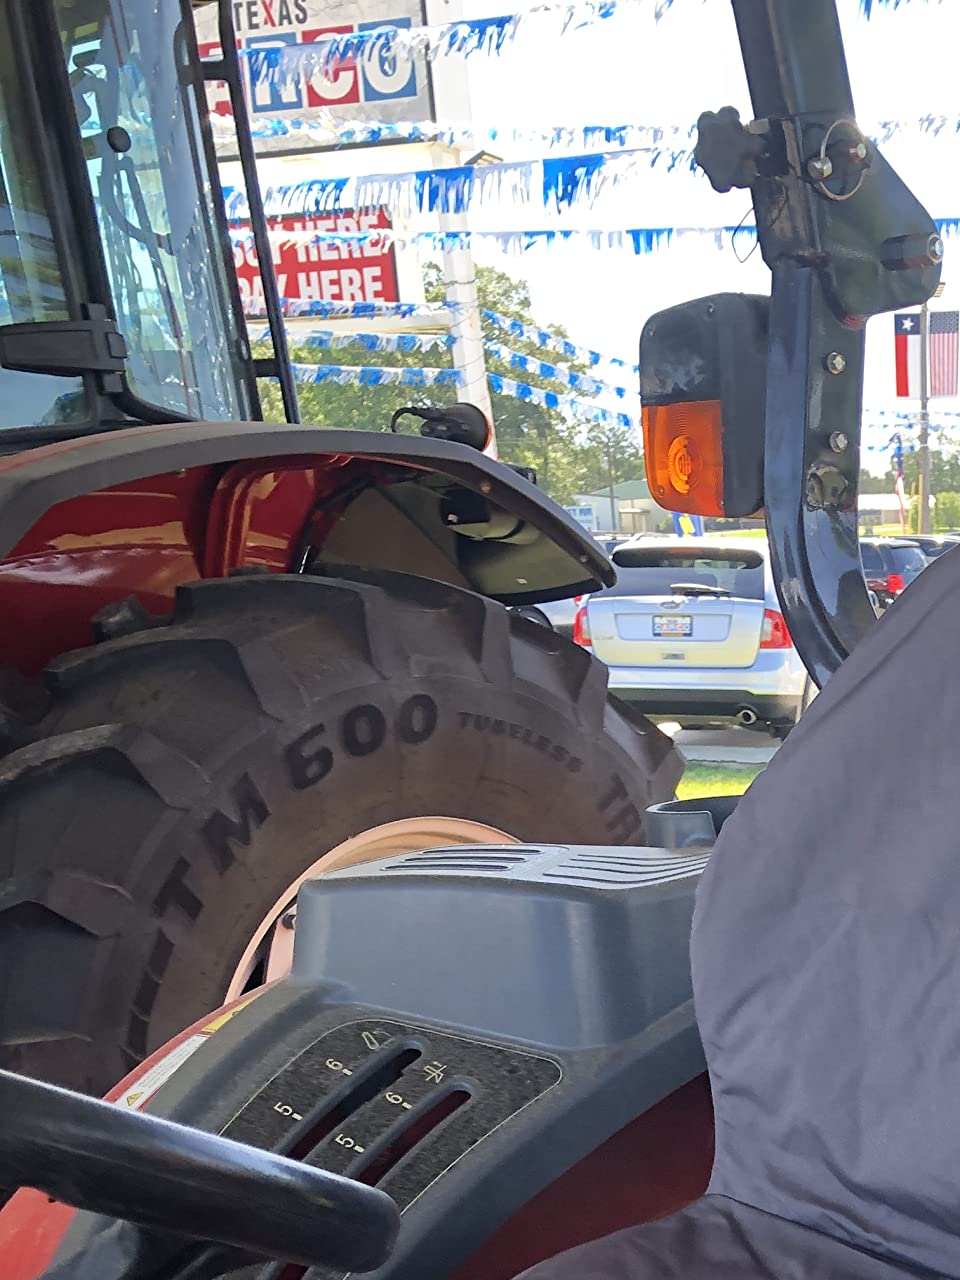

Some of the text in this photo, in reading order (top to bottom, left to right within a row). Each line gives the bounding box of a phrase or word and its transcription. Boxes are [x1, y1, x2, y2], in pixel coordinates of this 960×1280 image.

[234, 0, 307, 31] TEXAS
[295, 215, 383, 264] HERE
[297, 266, 386, 304] HERE
[457, 711, 584, 774] TUBELESS
[153, 693, 438, 922] TM 600
[273, 1101, 295, 1119] 5
[335, 1133, 356, 1149] 5
